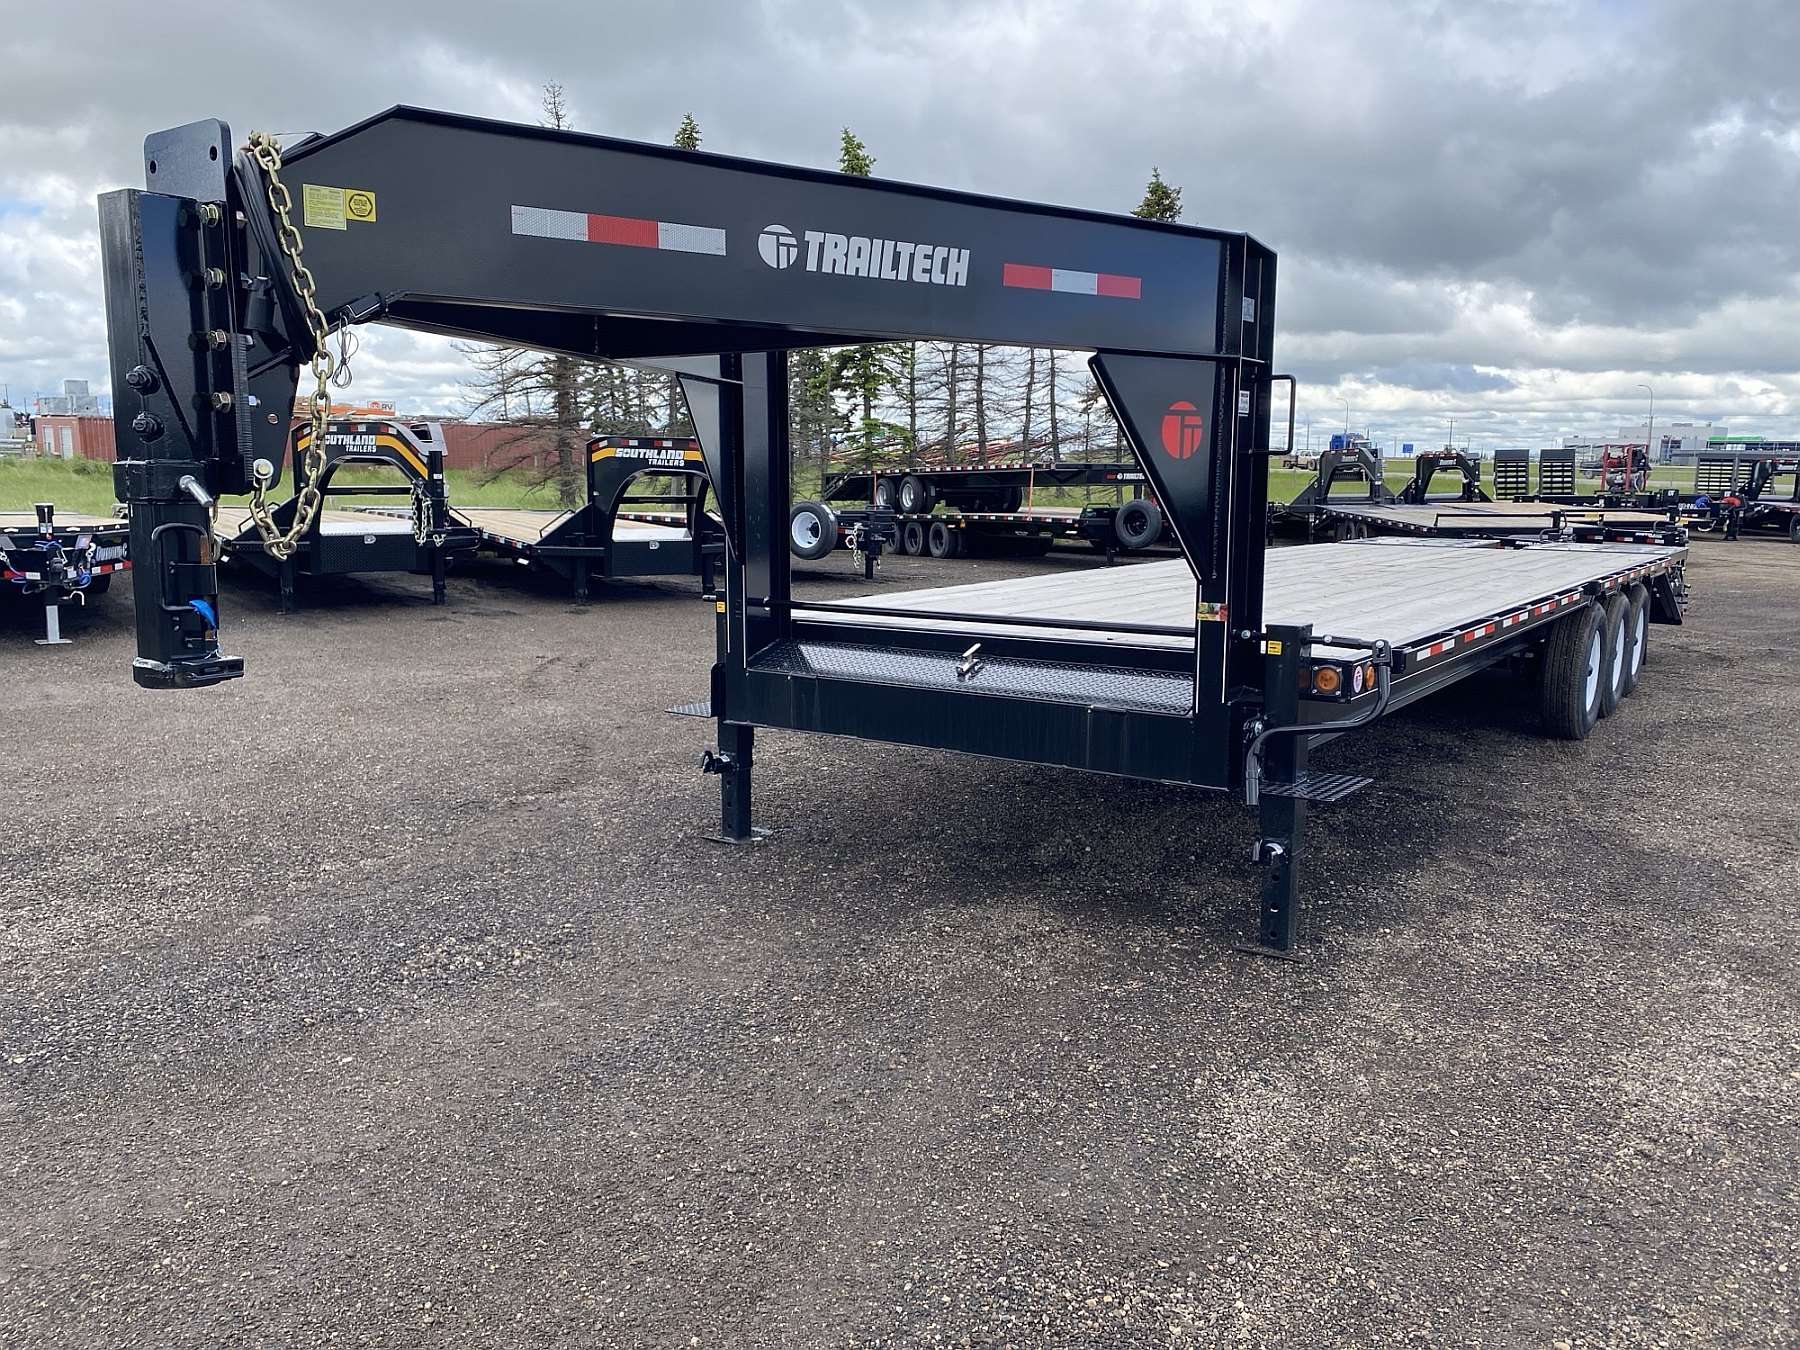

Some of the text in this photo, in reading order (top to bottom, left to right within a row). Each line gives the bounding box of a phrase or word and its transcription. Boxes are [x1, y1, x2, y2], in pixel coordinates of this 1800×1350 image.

[804, 230, 971, 287] TRAILTECH
[324, 434, 376, 446] OUTHLAND
[345, 445, 377, 453] TRAILERS
[615, 447, 685, 460] SOUTHLAND
[647, 458, 685, 467] TRAILERS
